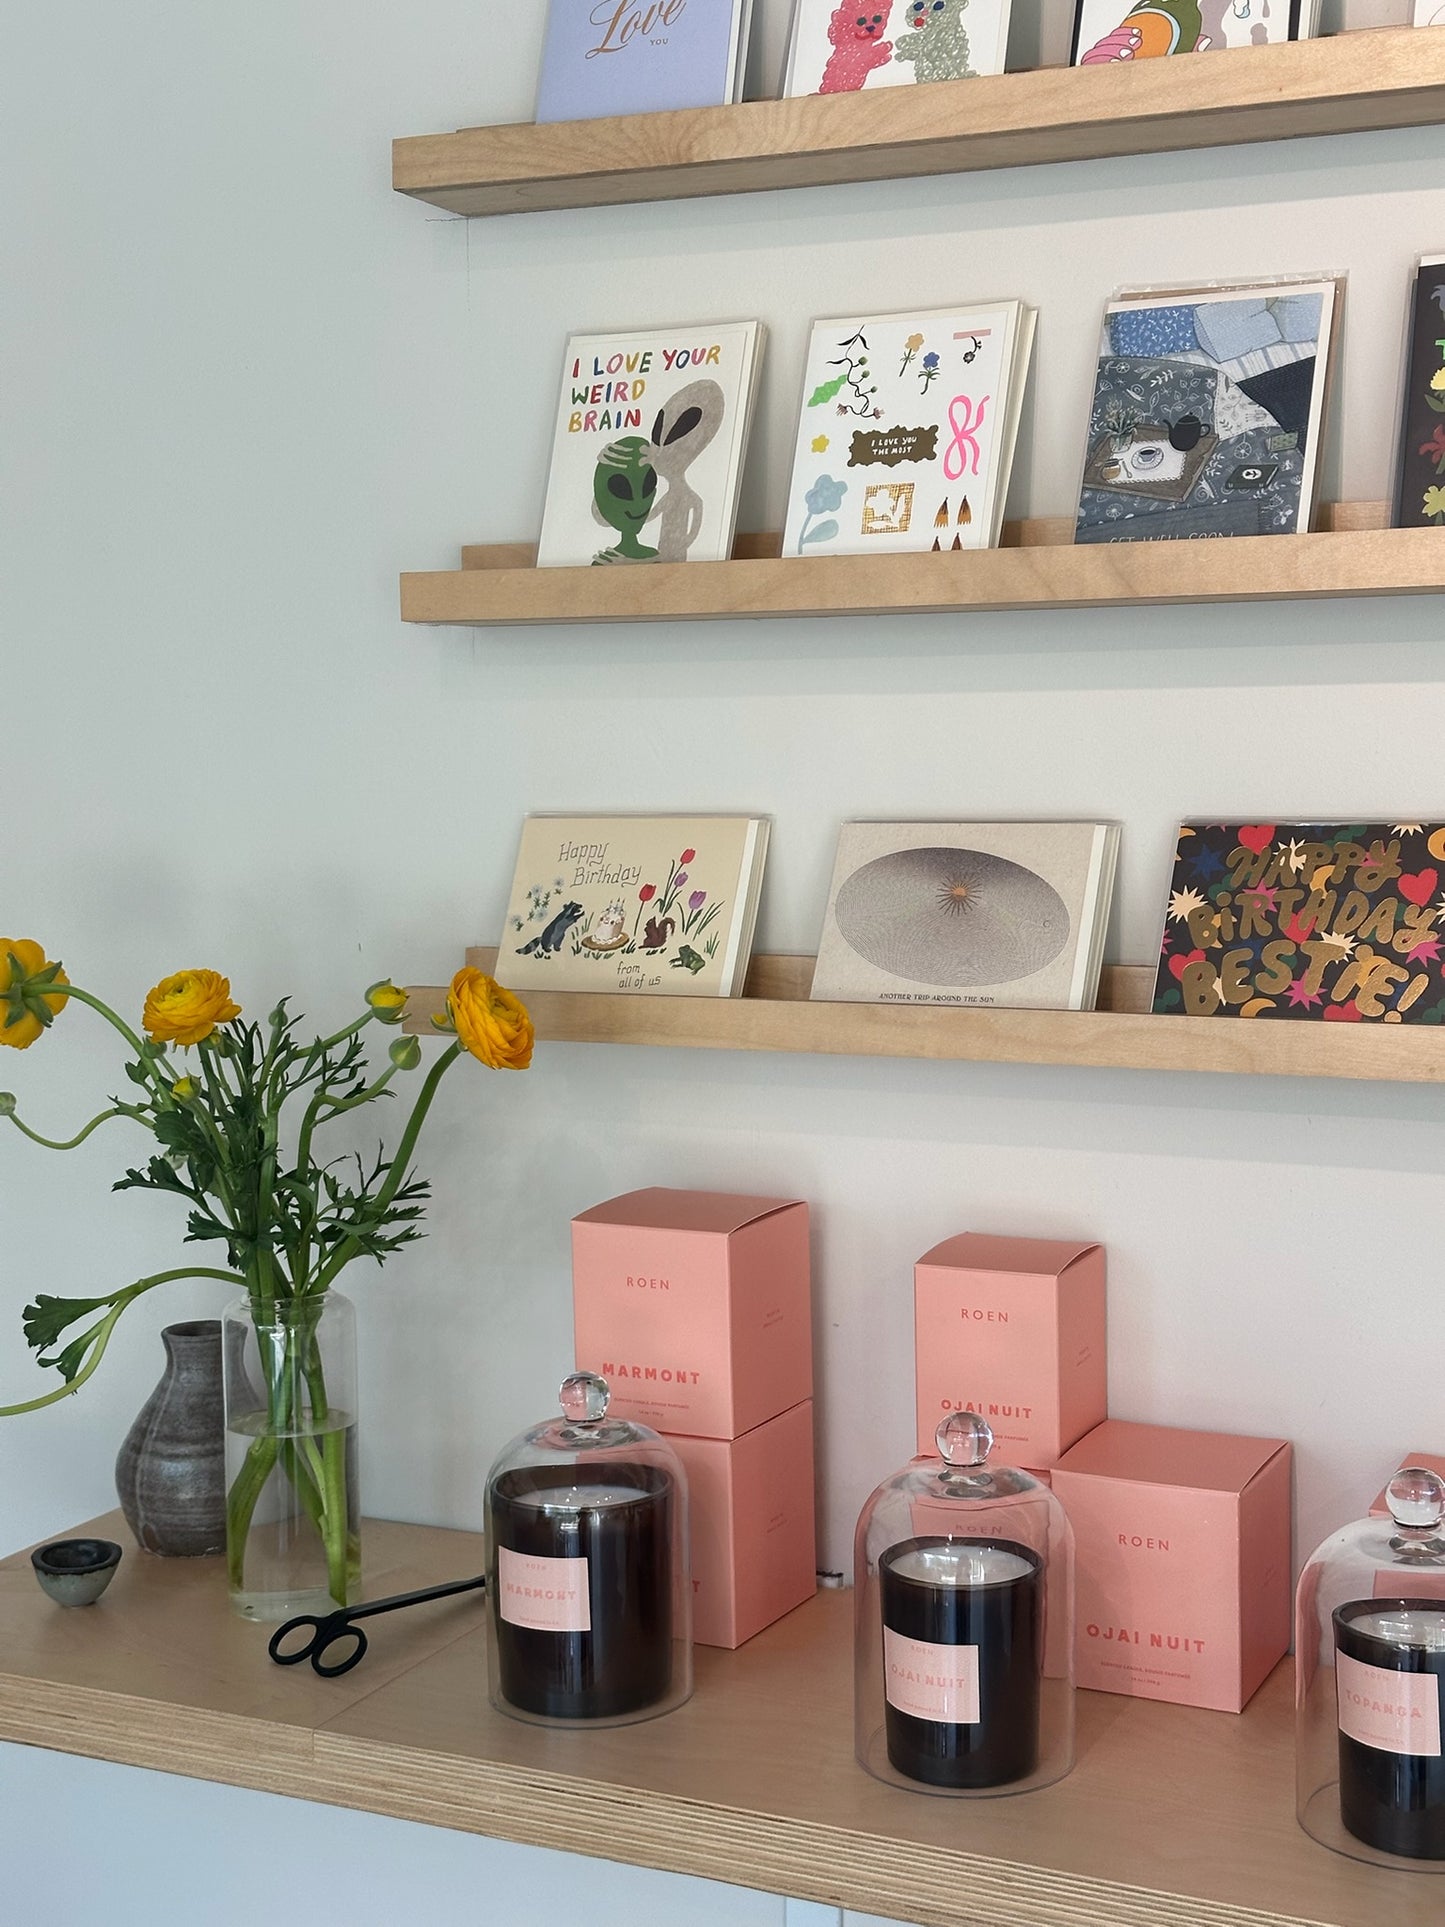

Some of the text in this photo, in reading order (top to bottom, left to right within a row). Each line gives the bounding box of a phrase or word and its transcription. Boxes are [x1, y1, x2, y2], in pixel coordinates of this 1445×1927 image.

[585, 0, 687, 59] Love
[650, 38, 669, 46] YOU
[571, 345, 721, 378] I LOVE YOUR
[571, 379, 646, 405] WEIRD
[568, 408, 641, 433] BRAIN
[871, 436, 918, 447] I LOVE YOU
[872, 446, 912, 456] THE MOST
[558, 841, 610, 866] Happy
[569, 863, 642, 888] Birthday
[617, 960, 640, 975] from
[618, 973, 662, 990] all of us
[879, 992, 912, 1001] ANOTHER
[914, 993, 930, 1001] TRIP
[932, 994, 962, 1003] AROUND
[626, 1276, 671, 1290] ROEN
[960, 1308, 1009, 1323] ROEN
[602, 1362, 700, 1385] MARMONT
[941, 1399, 1032, 1419] OJAI NUIT
[1118, 1533, 1170, 1552] ROEN
[1086, 1623, 1205, 1653] OJAI NUIT
[891, 1663, 965, 1689] OJAI NUIT
[1345, 1688, 1422, 1719] TOPANGA
